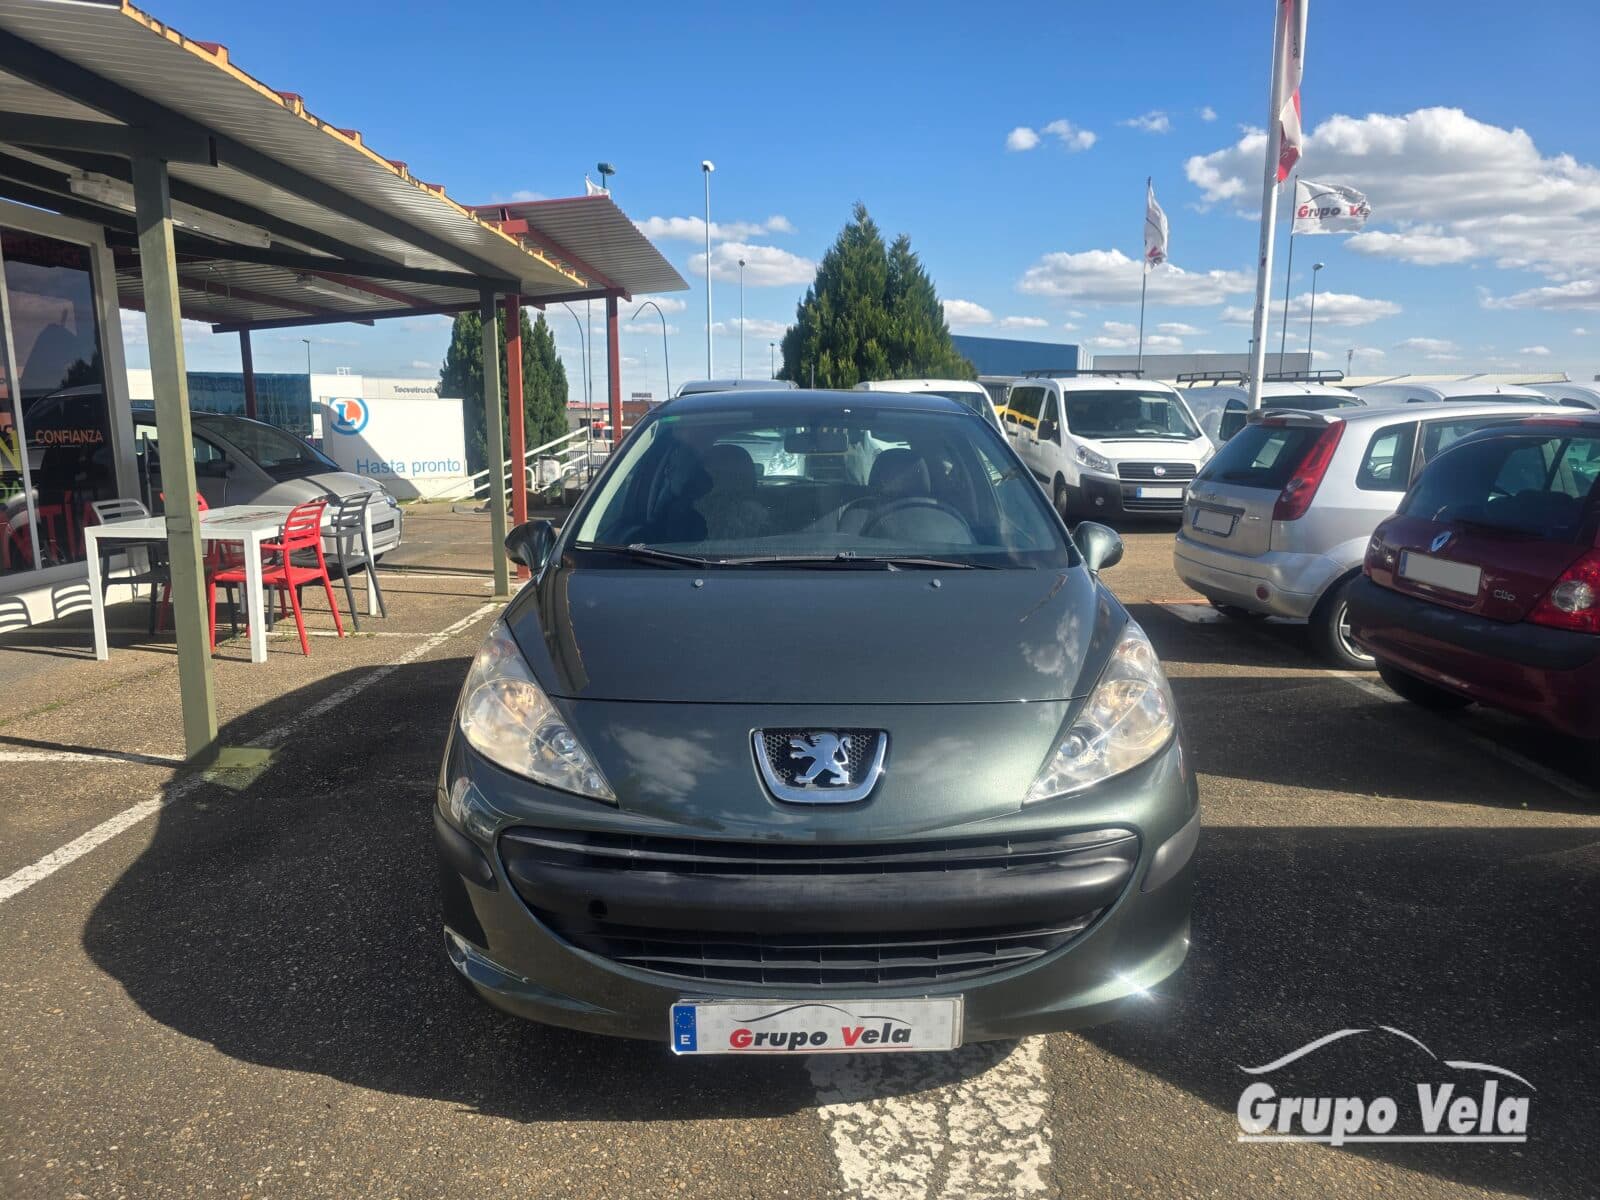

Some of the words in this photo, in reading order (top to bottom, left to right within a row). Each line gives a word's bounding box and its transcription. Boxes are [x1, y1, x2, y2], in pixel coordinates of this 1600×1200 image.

[1297, 205, 1341, 220] Grupo
[35, 429, 103, 444] CONFIANZA
[356, 458, 406, 474] Hasta
[412, 458, 461, 476] pronto
[680, 1034, 691, 1045] E
[729, 1028, 828, 1051] Grupo
[841, 1022, 912, 1047] Vela
